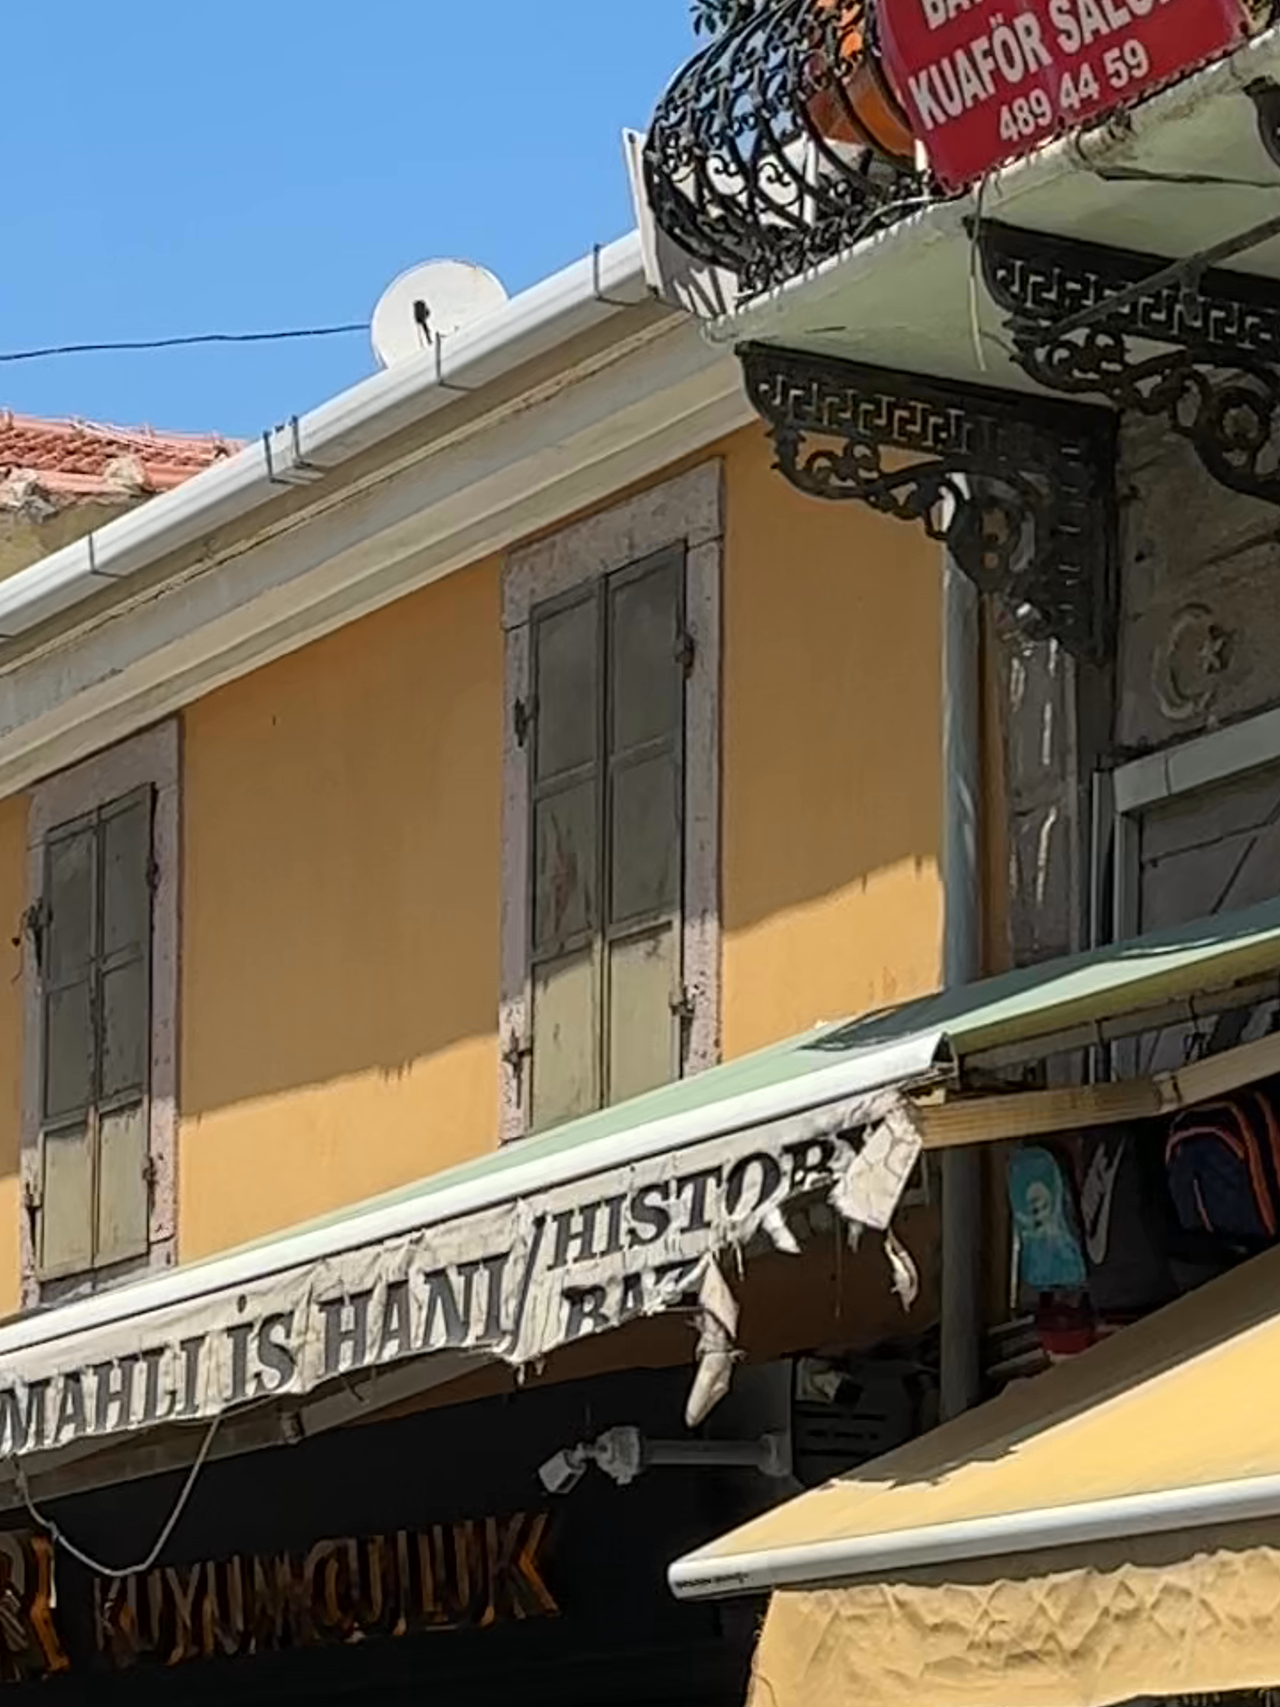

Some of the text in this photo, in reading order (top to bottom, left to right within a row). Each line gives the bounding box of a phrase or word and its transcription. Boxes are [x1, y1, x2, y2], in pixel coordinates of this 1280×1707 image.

[908, 12, 1052, 131] KUAFÖR
[999, 39, 1150, 142] 489 44 59
